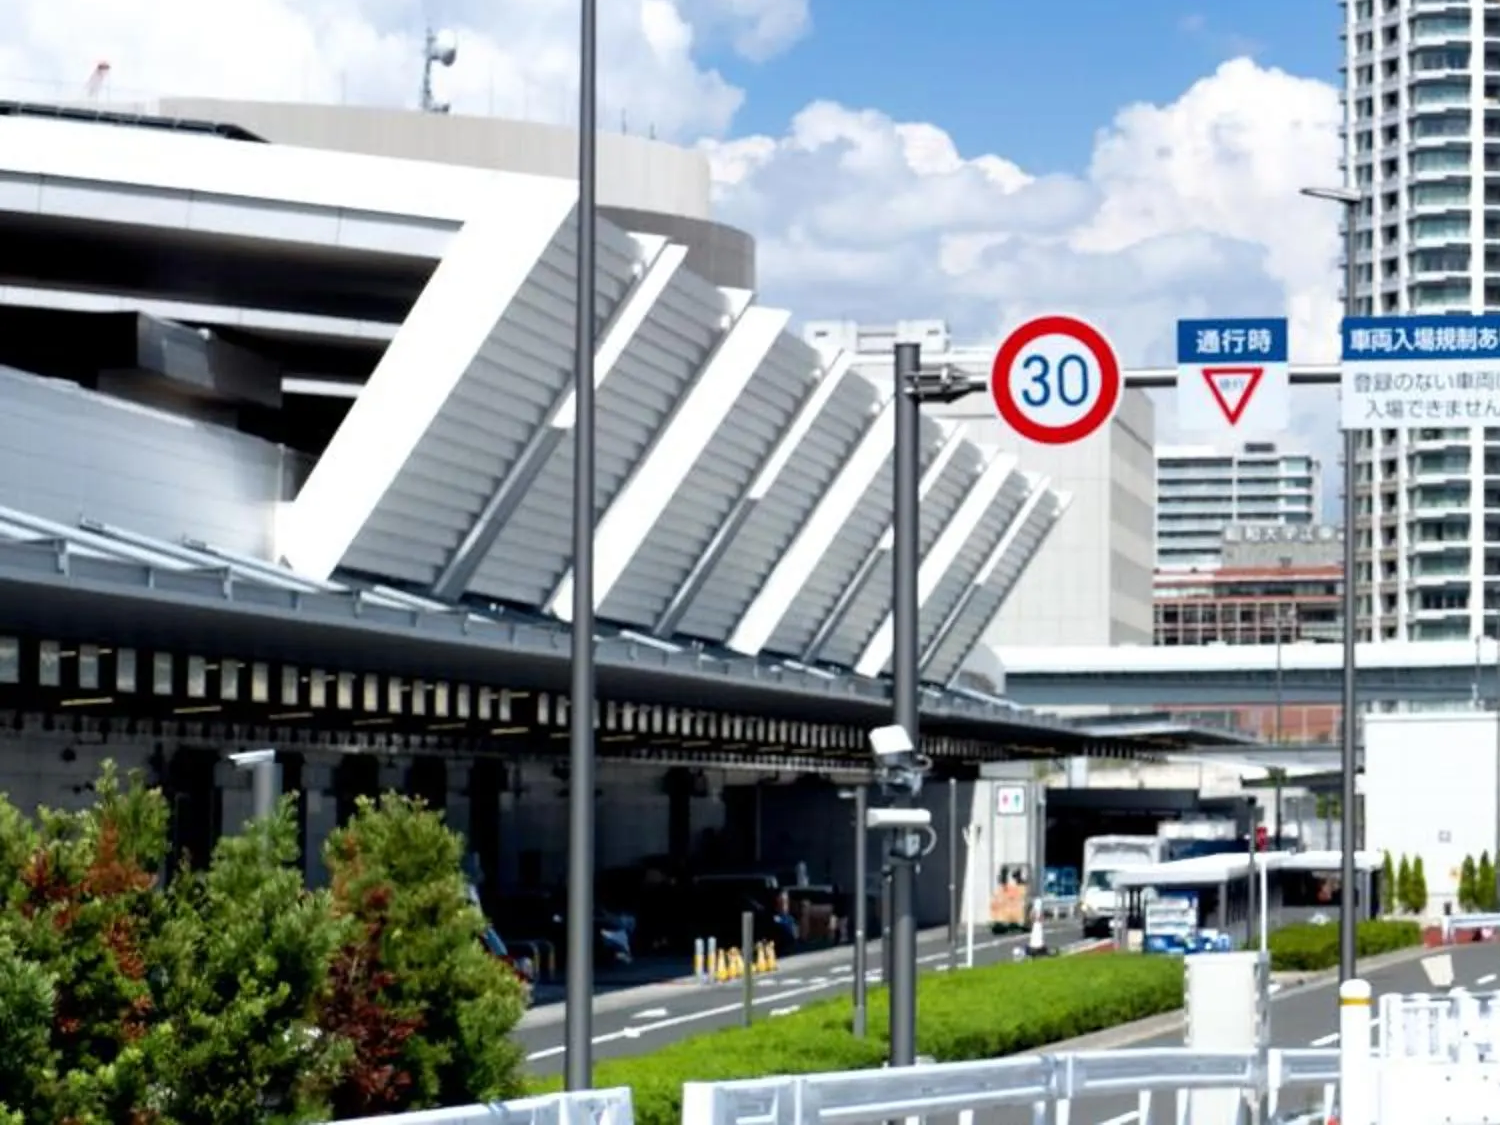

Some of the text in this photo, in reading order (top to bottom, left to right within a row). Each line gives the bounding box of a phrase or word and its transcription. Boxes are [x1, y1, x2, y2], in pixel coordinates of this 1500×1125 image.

[1195, 327, 1272, 354] 通行時
[1021, 354, 1090, 407] 30
